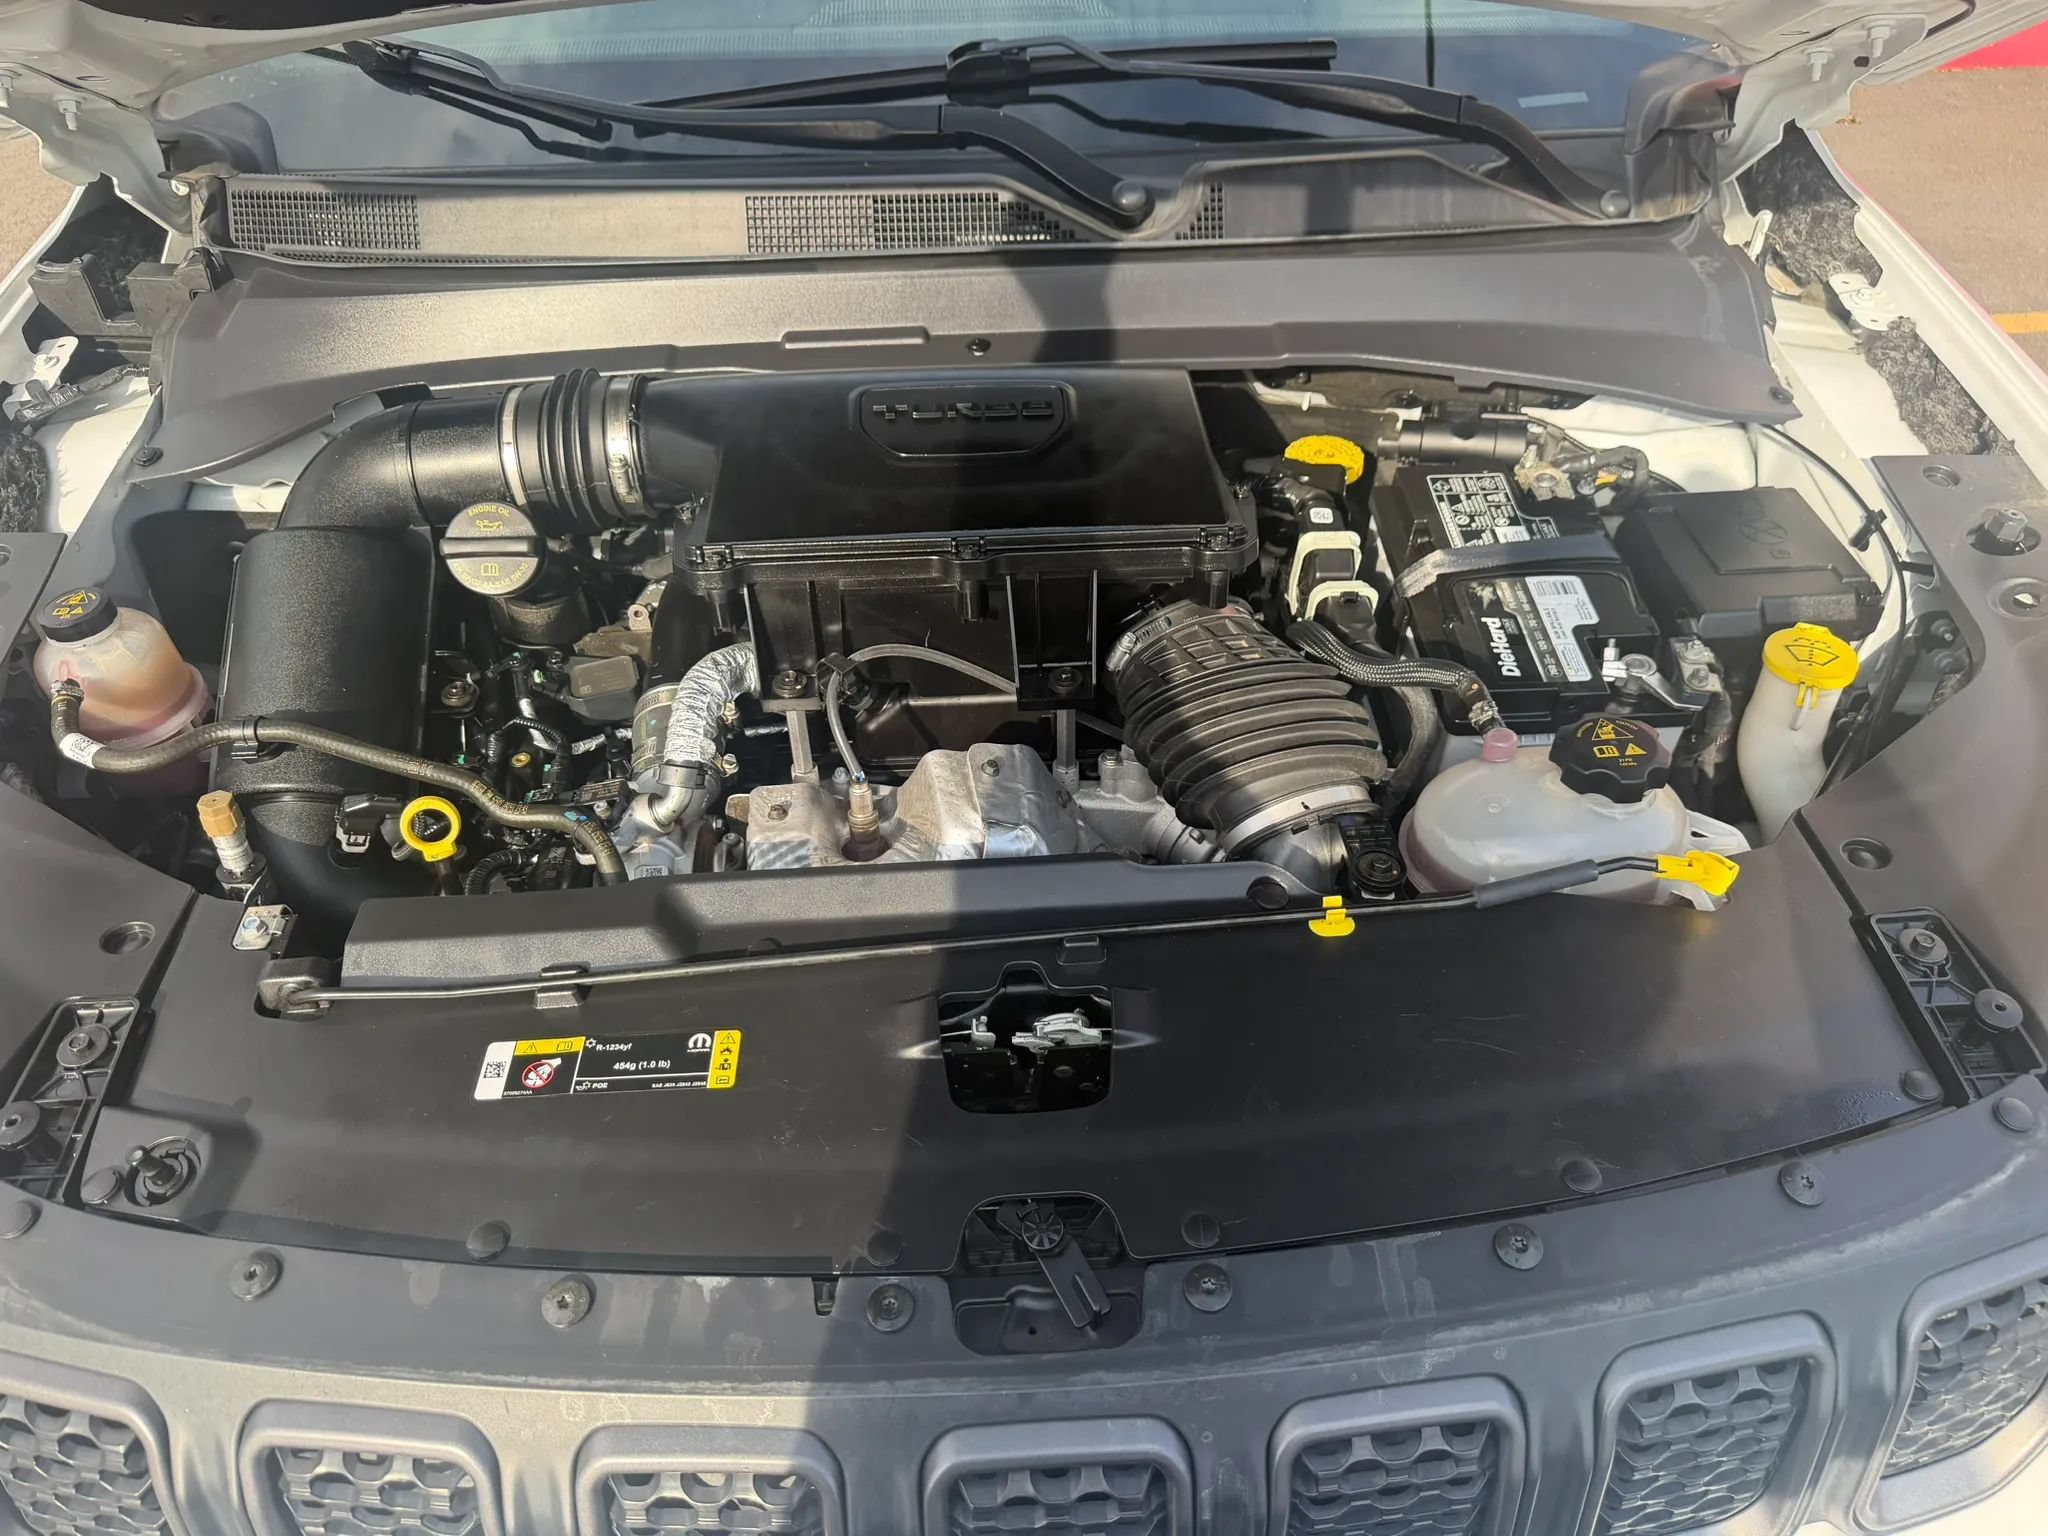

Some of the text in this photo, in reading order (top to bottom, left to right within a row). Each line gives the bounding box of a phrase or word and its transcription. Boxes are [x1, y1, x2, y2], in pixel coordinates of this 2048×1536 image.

[872, 401, 1053, 420] TURBO
[468, 505, 511, 517] ENGINE OIL
[1480, 616, 1522, 677] DieHard
[595, 1043, 633, 1051] R-1234yf
[613, 1060, 671, 1071] 454g (1.0 lb)
